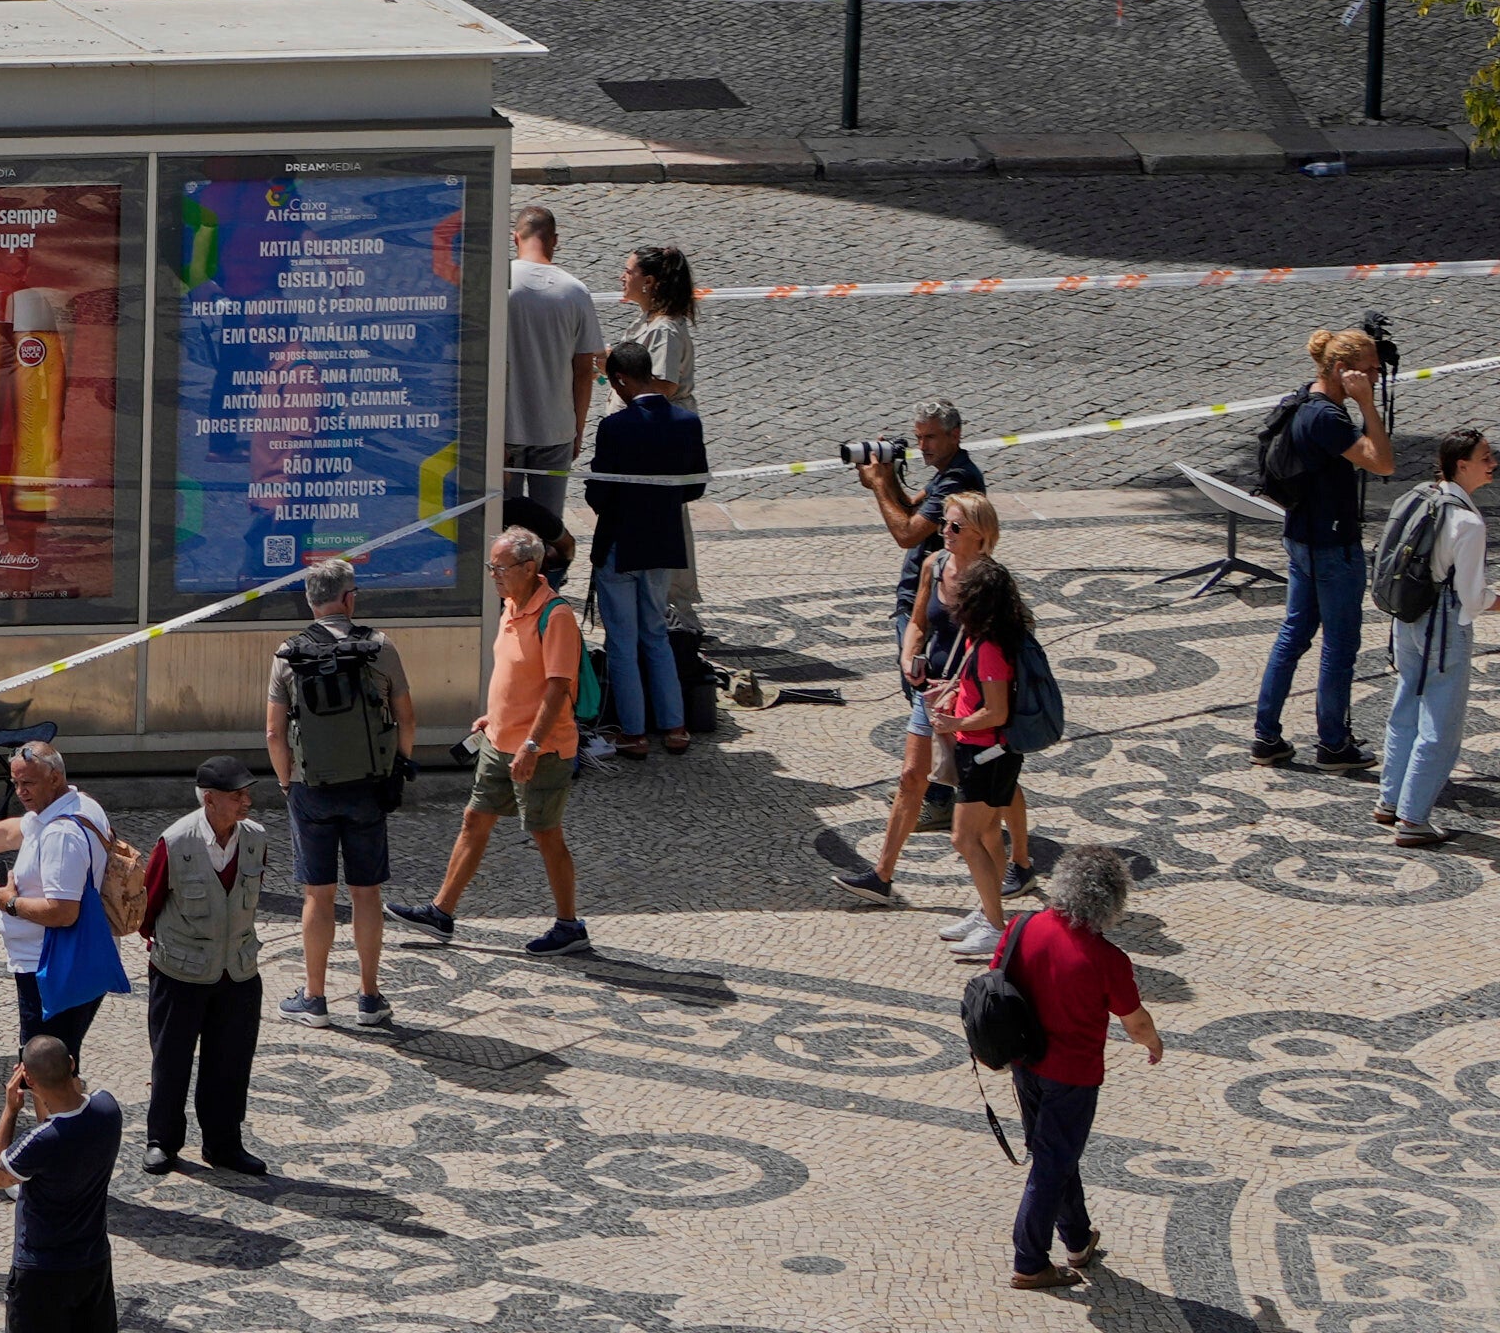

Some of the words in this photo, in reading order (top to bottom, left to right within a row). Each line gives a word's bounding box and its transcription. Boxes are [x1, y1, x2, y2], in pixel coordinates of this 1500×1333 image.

[289, 199, 326, 211] Caixa
[0, 208, 57, 229] sempre
[266, 209, 327, 222] Alfama
[260, 239, 301, 257] KATIA
[303, 238, 384, 256] GUERREIRO
[278, 271, 326, 288] GISELA
[329, 267, 365, 289] JOÃO
[192, 300, 241, 316] HELDER
[244, 299, 315, 315] MOUTINHO
[330, 298, 373, 314] PEDRO
[375, 296, 447, 312] MOUTINHO
[222, 329, 246, 344] EM
[249, 327, 286, 344] CASA
[290, 322, 357, 343] D'AMÁLIA
[361, 325, 379, 341] AO
[382, 324, 416, 340] VIVO
[22, 351, 40, 359] BOCK
[269, 351, 285, 361] POR
[286, 350, 306, 361] JOSÉ
[233, 369, 277, 385] MARIA
[279, 369, 297, 384] DA
[300, 365, 319, 385] FÉ,
[320, 367, 347, 383] ANA
[349, 367, 402, 383] MOURA,
[222, 391, 281, 409] ANTÓNIO
[283, 392, 349, 408] ZAMBUJO,
[351, 387, 411, 407] CAMANÉ,
[196, 418, 237, 436] JORGE
[239, 417, 312, 433] FERNANDO,
[313, 412, 346, 433] JOSÉ
[348, 414, 403, 430] MANUEL
[406, 413, 440, 428] NETO
[269, 440, 313, 449] CELEBRAM
[314, 439, 341, 448] MARIA
[342, 439, 353, 447] DA
[354, 437, 364, 447] FÉ
[283, 454, 312, 475] RÃO
[315, 457, 352, 473] KYAO
[248, 482, 301, 498] MARCO
[304, 480, 386, 497] RODRIGUES
[275, 503, 359, 520] ALEXANDRA
[313, 536, 341, 544] MUITO
[342, 535, 364, 544] MAIS
